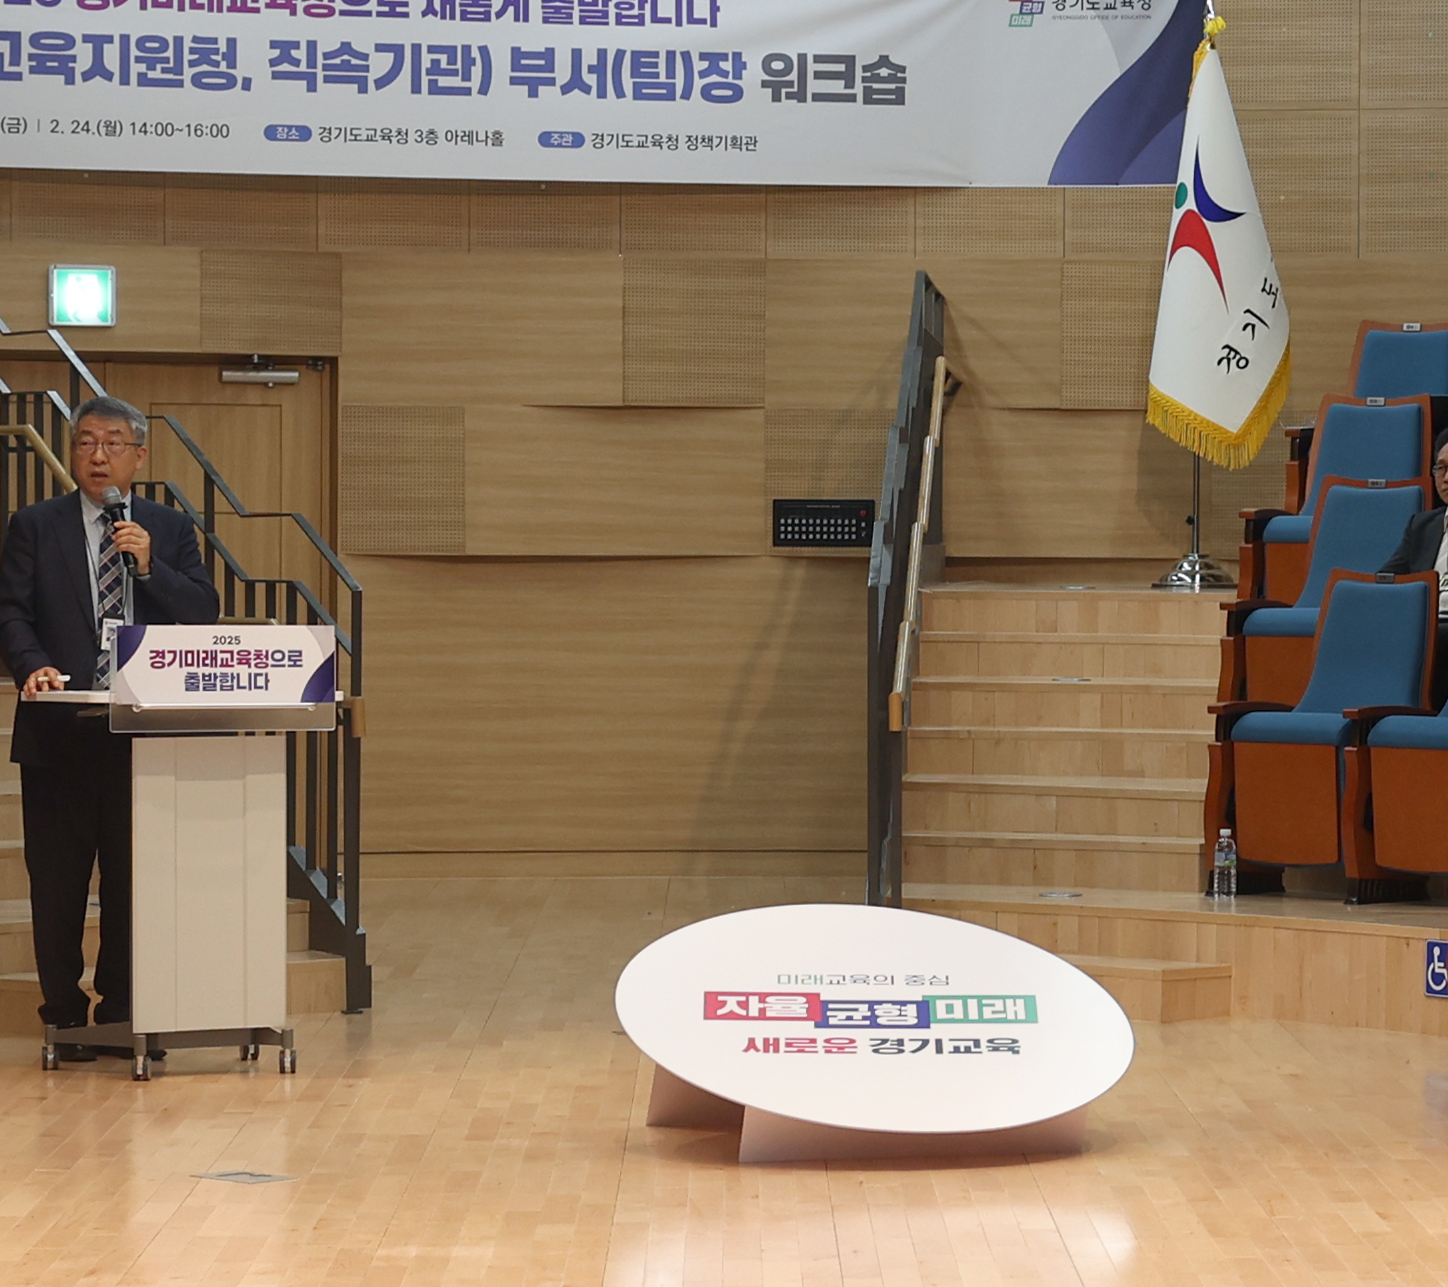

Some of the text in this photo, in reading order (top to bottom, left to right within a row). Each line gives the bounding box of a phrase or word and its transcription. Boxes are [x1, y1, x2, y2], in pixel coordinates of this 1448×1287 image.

[270, 39, 493, 97] 직속기관)
[509, 45, 746, 103] 부서(팀)장
[759, 51, 908, 107] 워크숍
[49, 119, 65, 134] 2.
[70, 119, 124, 138] 24.(월)
[129, 121, 230, 139] 14:00~16:00
[275, 126, 301, 140] 장소
[318, 125, 410, 145] 경기도교육청
[414, 128, 440, 146] 3층
[444, 129, 505, 148] 아레나홀
[550, 133, 574, 147] 주관
[591, 132, 681, 151] 경기도교육청
[684, 134, 759, 153] 정책기획관
[212, 635, 241, 645] 2025
[148, 649, 304, 670] 경기미래교육청으로
[183, 671, 271, 692] 출발합니다
[776, 973, 950, 988] 미래교육의 중심
[716, 994, 1027, 1027] 자율 균형 미래
[741, 1037, 1022, 1055] 새로운 경기교육
